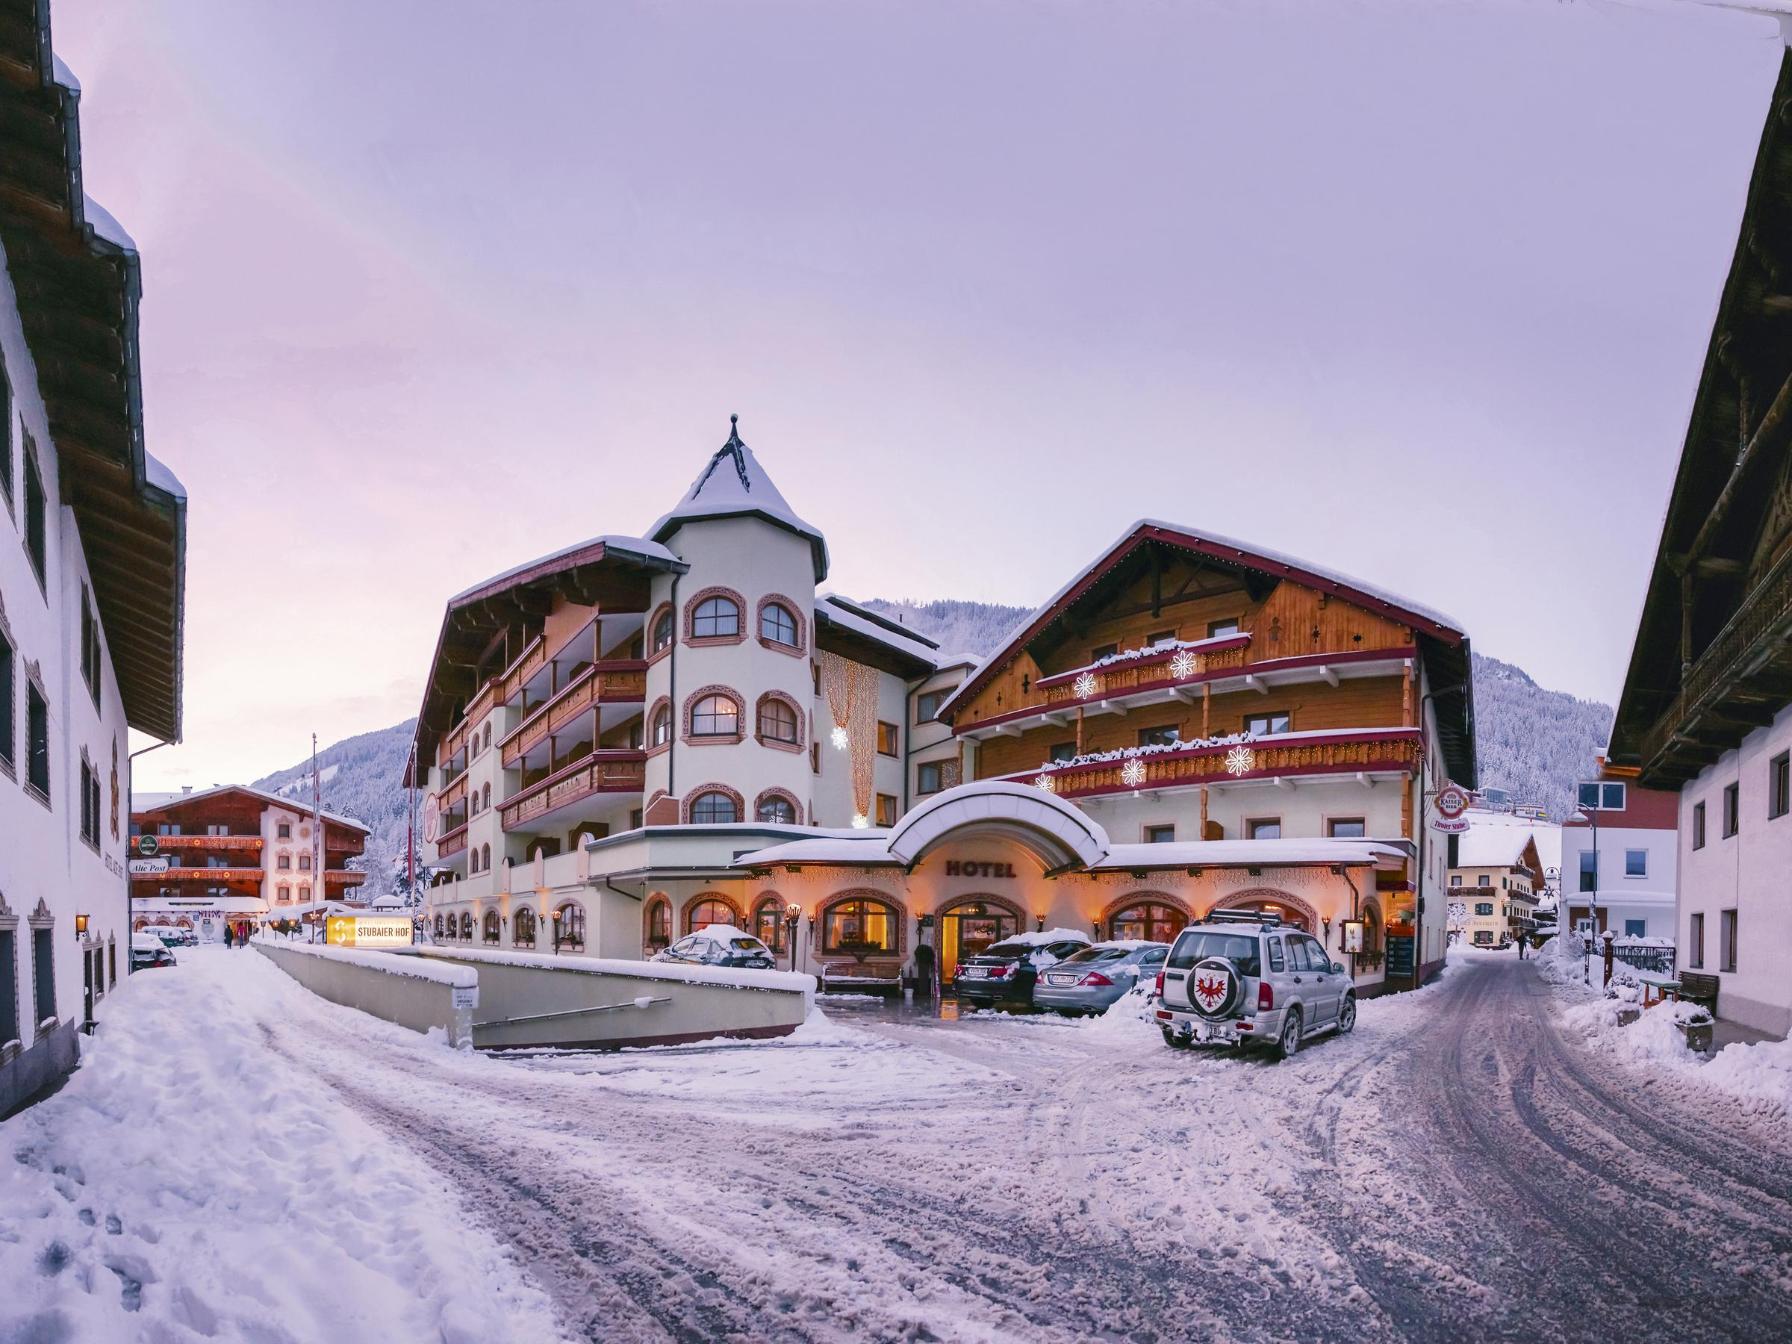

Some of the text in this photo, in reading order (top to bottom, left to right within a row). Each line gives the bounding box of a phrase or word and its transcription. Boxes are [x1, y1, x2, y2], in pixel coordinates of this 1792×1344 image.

[1440, 799, 1462, 807] KAISER
[133, 864, 166, 872] Alte Post
[945, 861, 1017, 878] HOTEL
[358, 927, 410, 937] STUBAIER HOF
